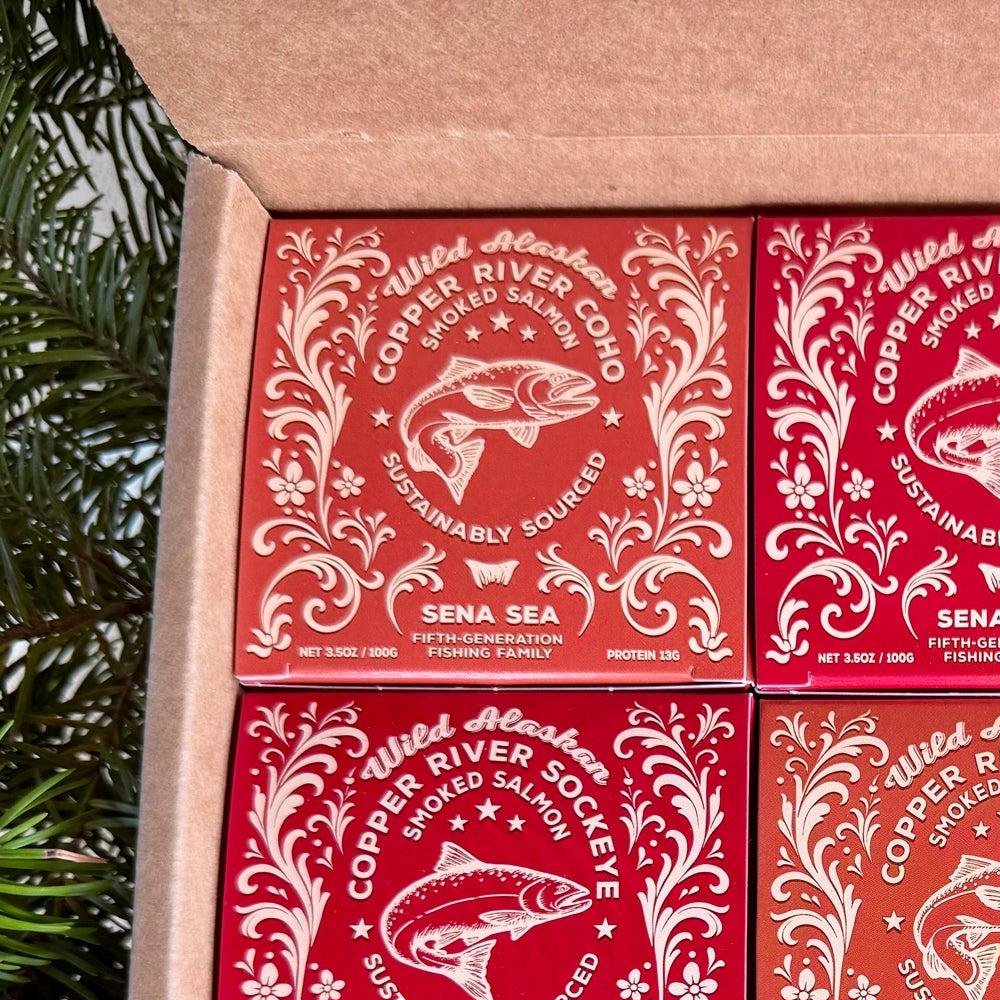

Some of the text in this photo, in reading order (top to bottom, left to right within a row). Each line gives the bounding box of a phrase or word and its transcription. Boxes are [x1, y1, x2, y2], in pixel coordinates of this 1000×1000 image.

[372, 260, 625, 384] COPPER RIVER COHO
[421, 286, 580, 351] SMOKED SALMON
[872, 285, 938, 405] COPPER
[921, 283, 994, 348] SMOKED
[382, 451, 606, 544] SUSTAINABLY SOURCED
[412, 632, 563, 645] FIFTH-GENERATION
[421, 604, 560, 625] SENA SEA
[427, 646, 553, 659] FISHING FAMILY
[606, 649, 681, 661] PROTEIN 13G
[817, 652, 841, 664] NET
[843, 652, 876, 664] 3.5OZ
[886, 652, 915, 664] 100G
[884, 721, 973, 788] Wild
[348, 739, 620, 900] COPPER RIVER SOCKEYE
[402, 770, 571, 841] SMOKED SALMON
[881, 765, 967, 884] COPPER
